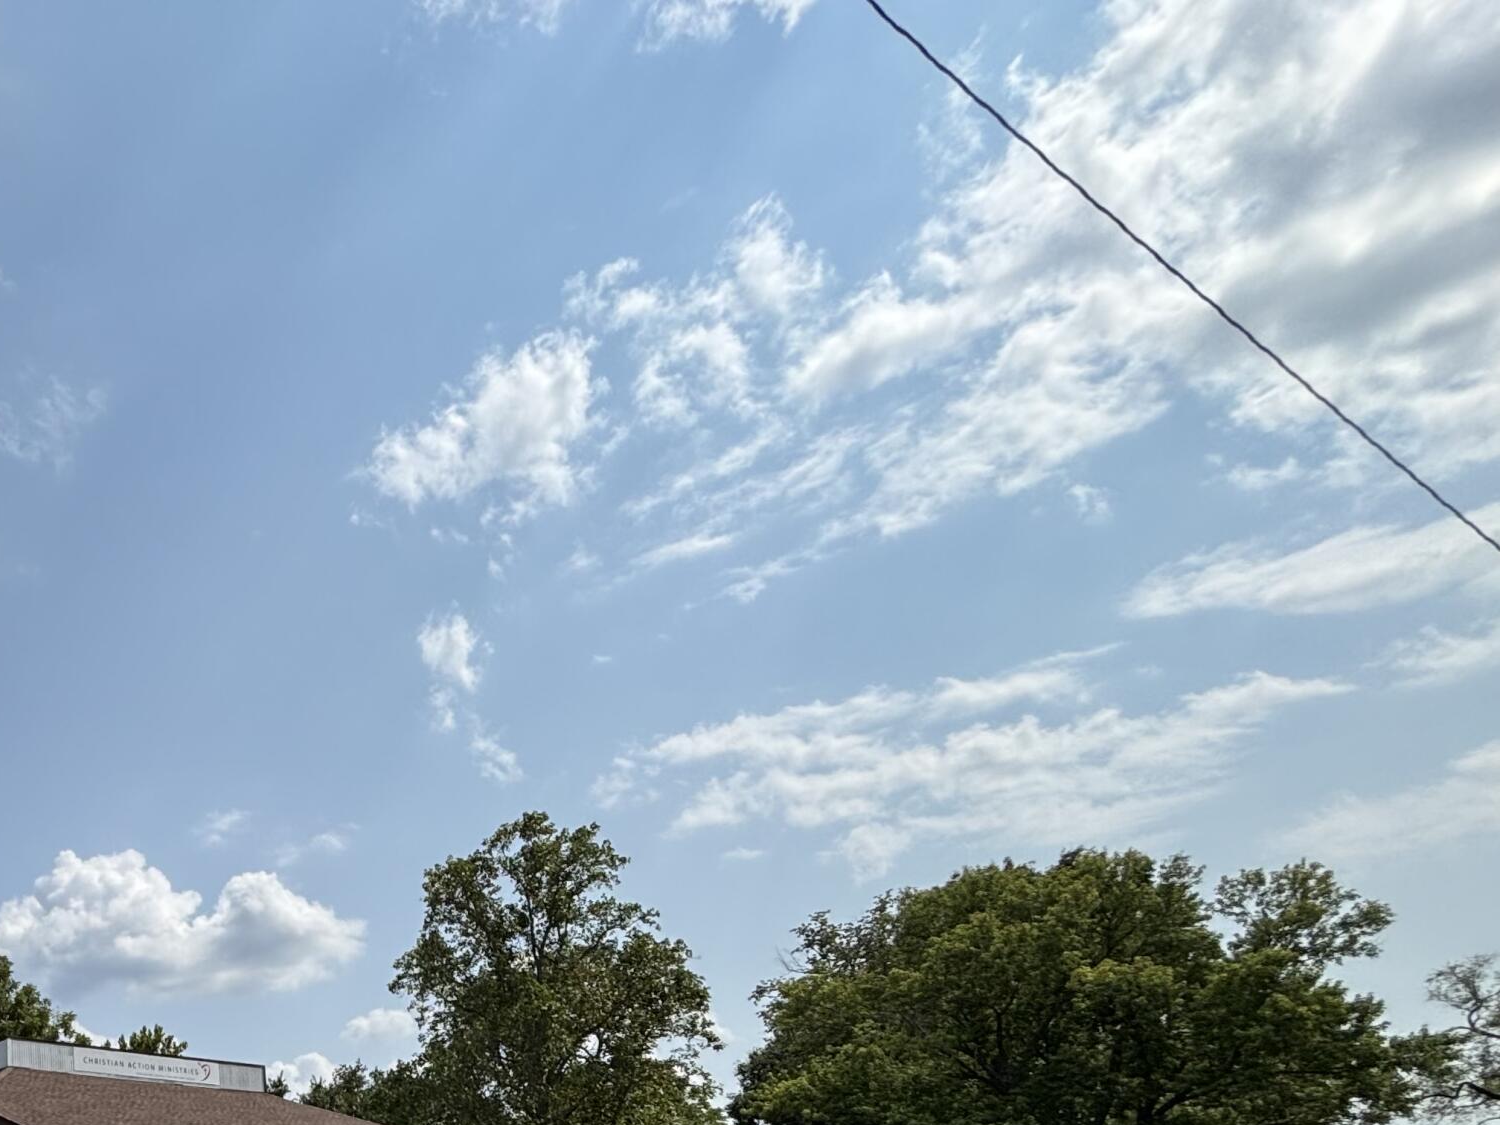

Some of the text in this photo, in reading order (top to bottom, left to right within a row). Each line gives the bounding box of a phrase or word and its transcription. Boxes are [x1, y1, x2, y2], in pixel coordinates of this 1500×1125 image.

[83, 1056, 125, 1068] CHRISTIAN
[127, 1062, 156, 1071] ACTION
[158, 1065, 199, 1076] MINISTRIES
